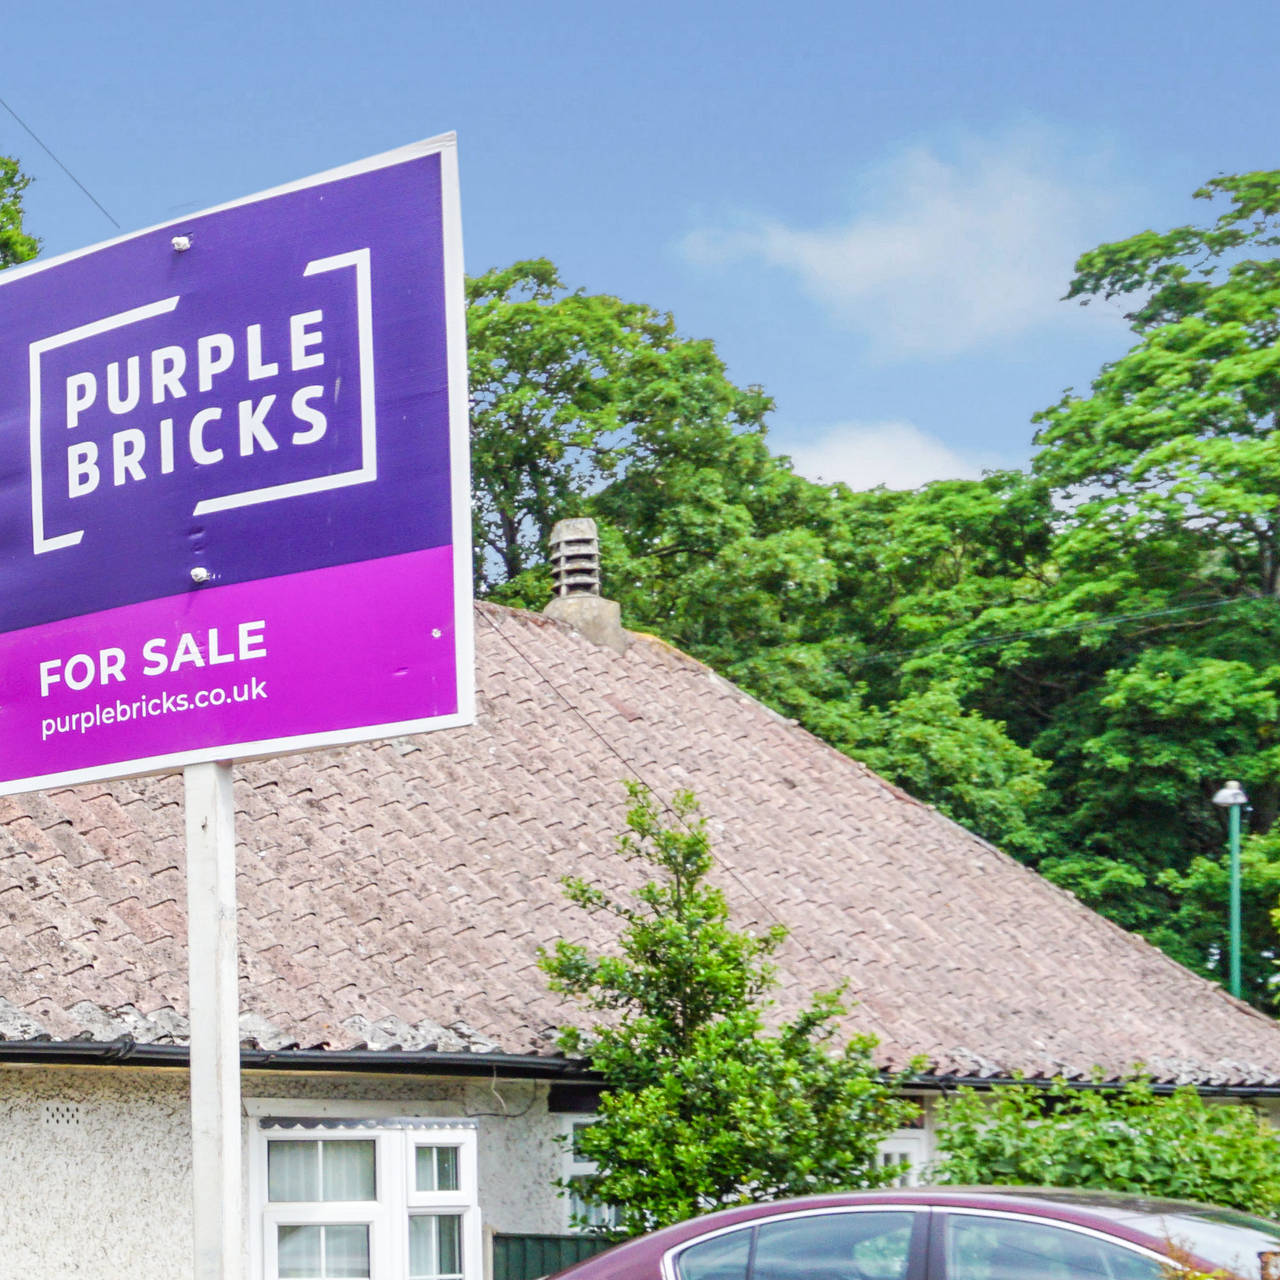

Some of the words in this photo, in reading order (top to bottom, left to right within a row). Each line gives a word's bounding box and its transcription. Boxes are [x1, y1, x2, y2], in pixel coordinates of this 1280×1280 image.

[66, 309, 325, 429] PURPLE
[67, 385, 328, 498] BRICKS
[39, 647, 126, 697] FOR
[142, 620, 267, 676] SALE
[42, 677, 268, 741] purplebricks.co.uk
